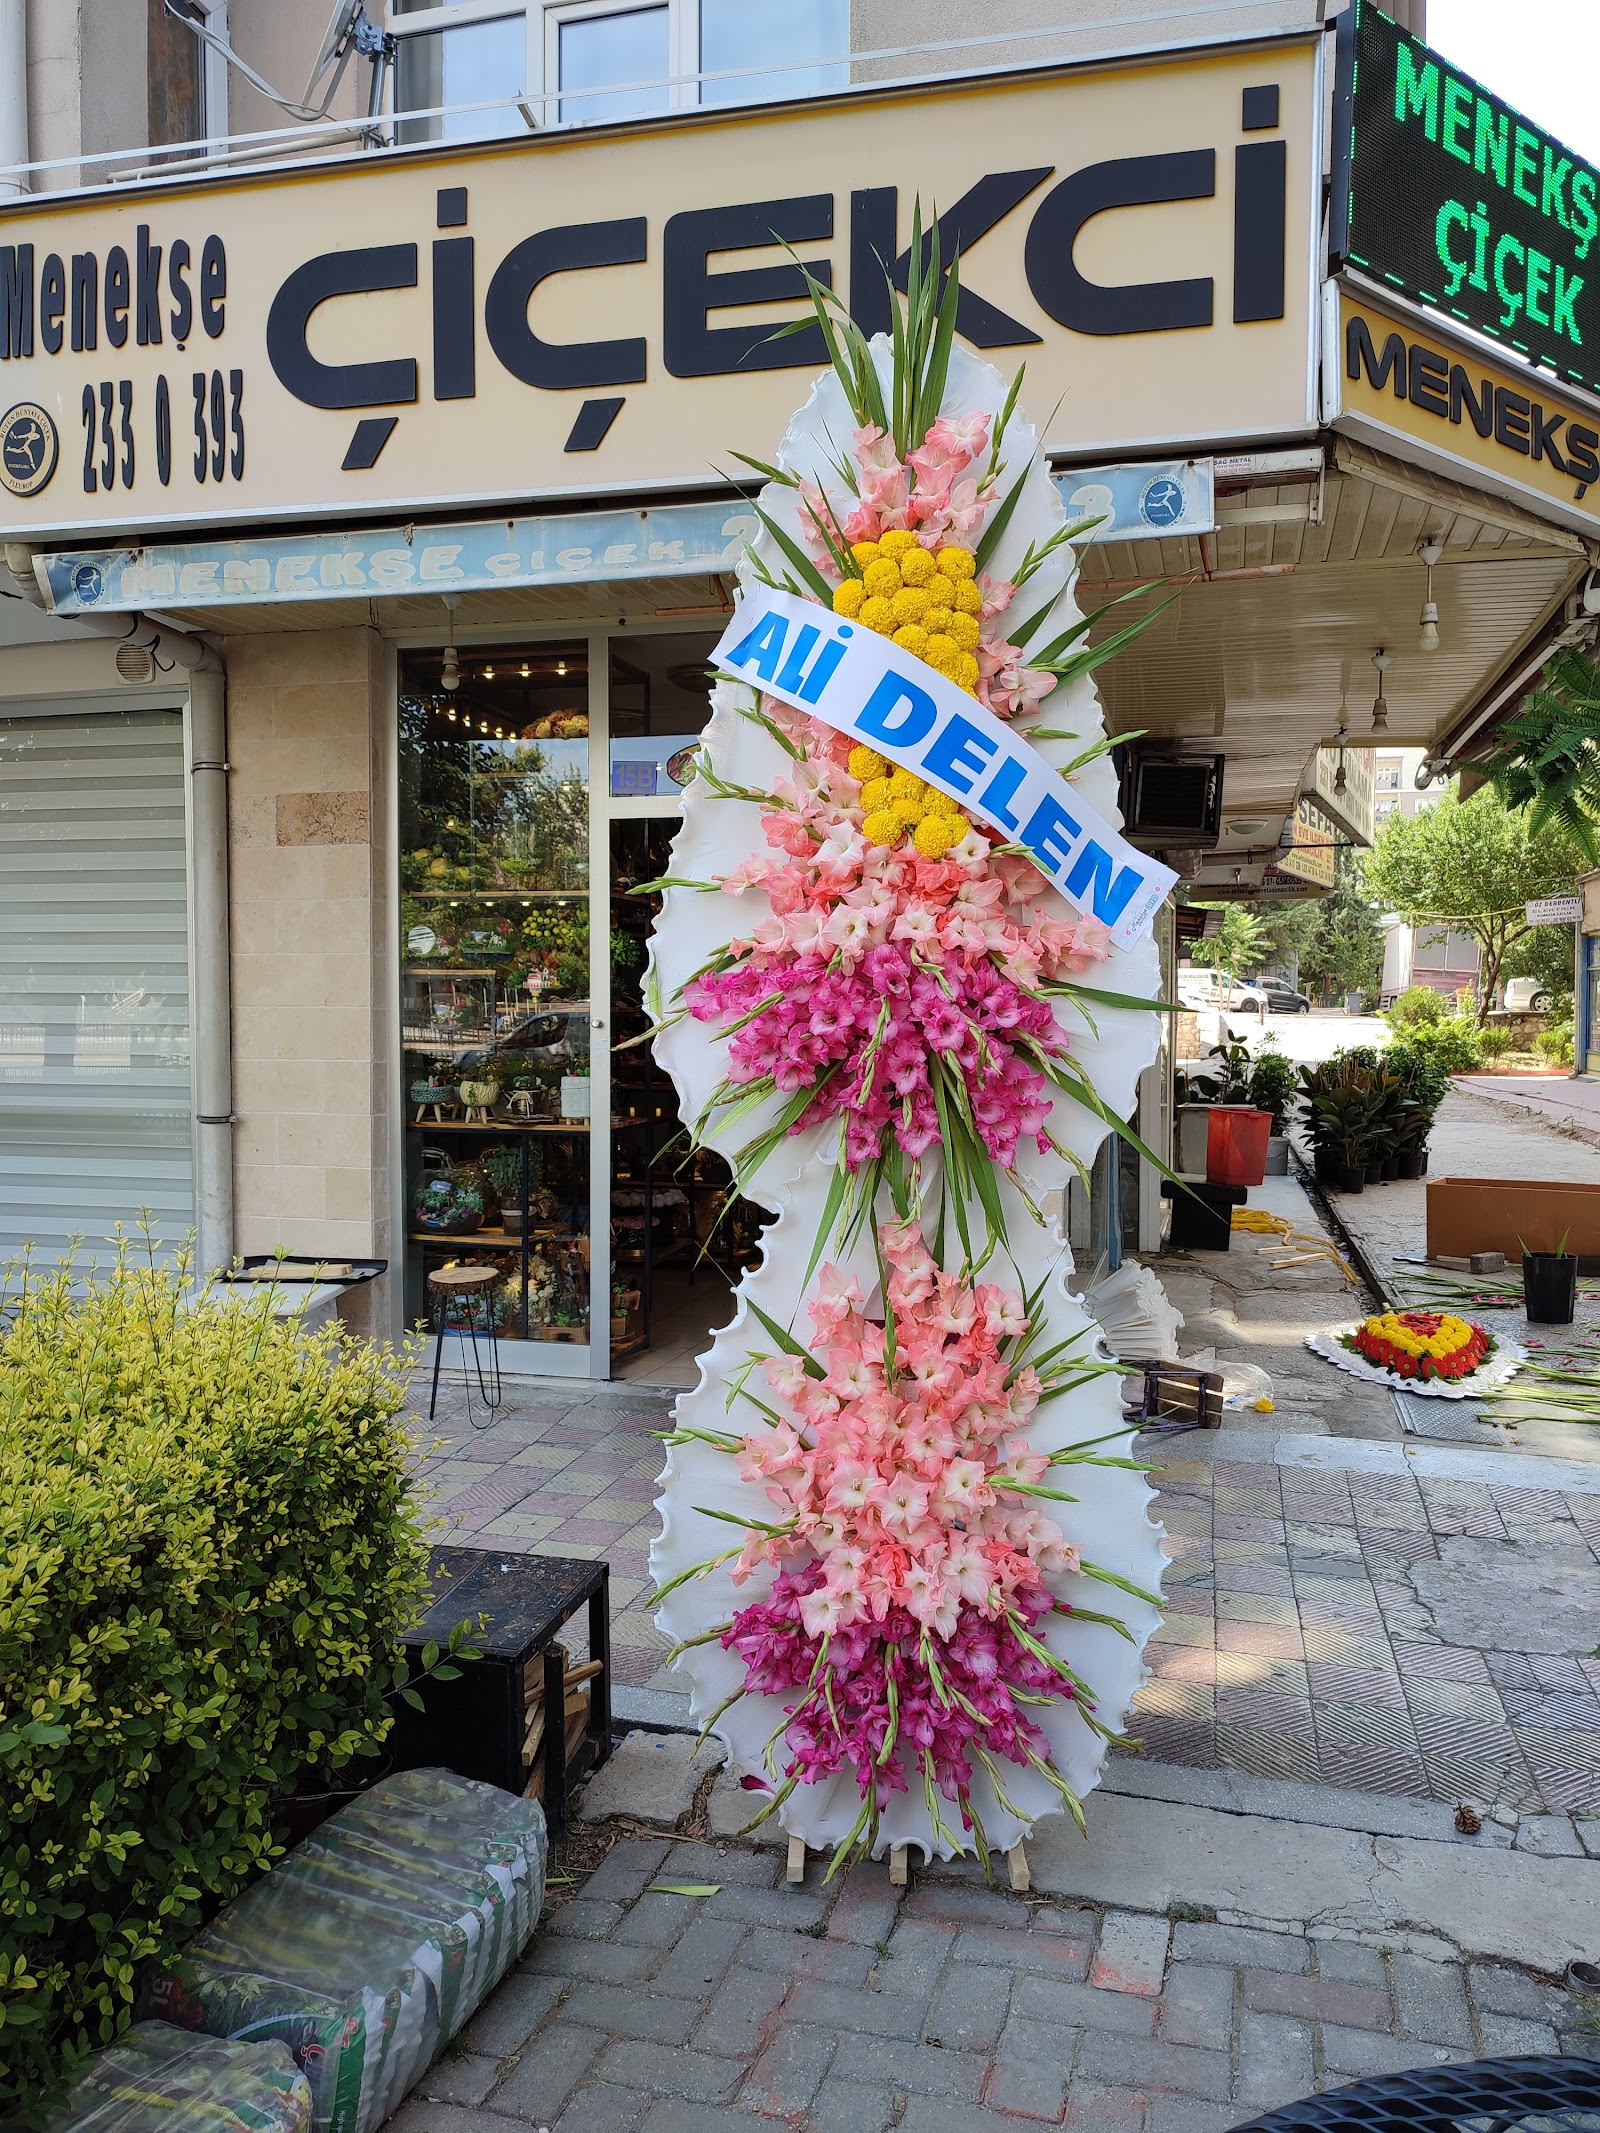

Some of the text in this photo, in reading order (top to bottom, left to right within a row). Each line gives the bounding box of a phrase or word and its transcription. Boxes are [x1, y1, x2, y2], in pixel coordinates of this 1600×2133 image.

[0, 224, 226, 359] Menekşe
[266, 83, 1286, 471] ÇİÇEKCİ
[1435, 199, 1582, 345] ÇİÇEK
[82, 369, 245, 493] 233 0 393
[1346, 316, 1600, 499] MENEKŞ
[9, 479, 34, 490] FLEUROP
[616, 765, 653, 788] 15B
[725, 610, 1145, 927] ALİ DELEN
[1299, 797, 1333, 837] SEFA
